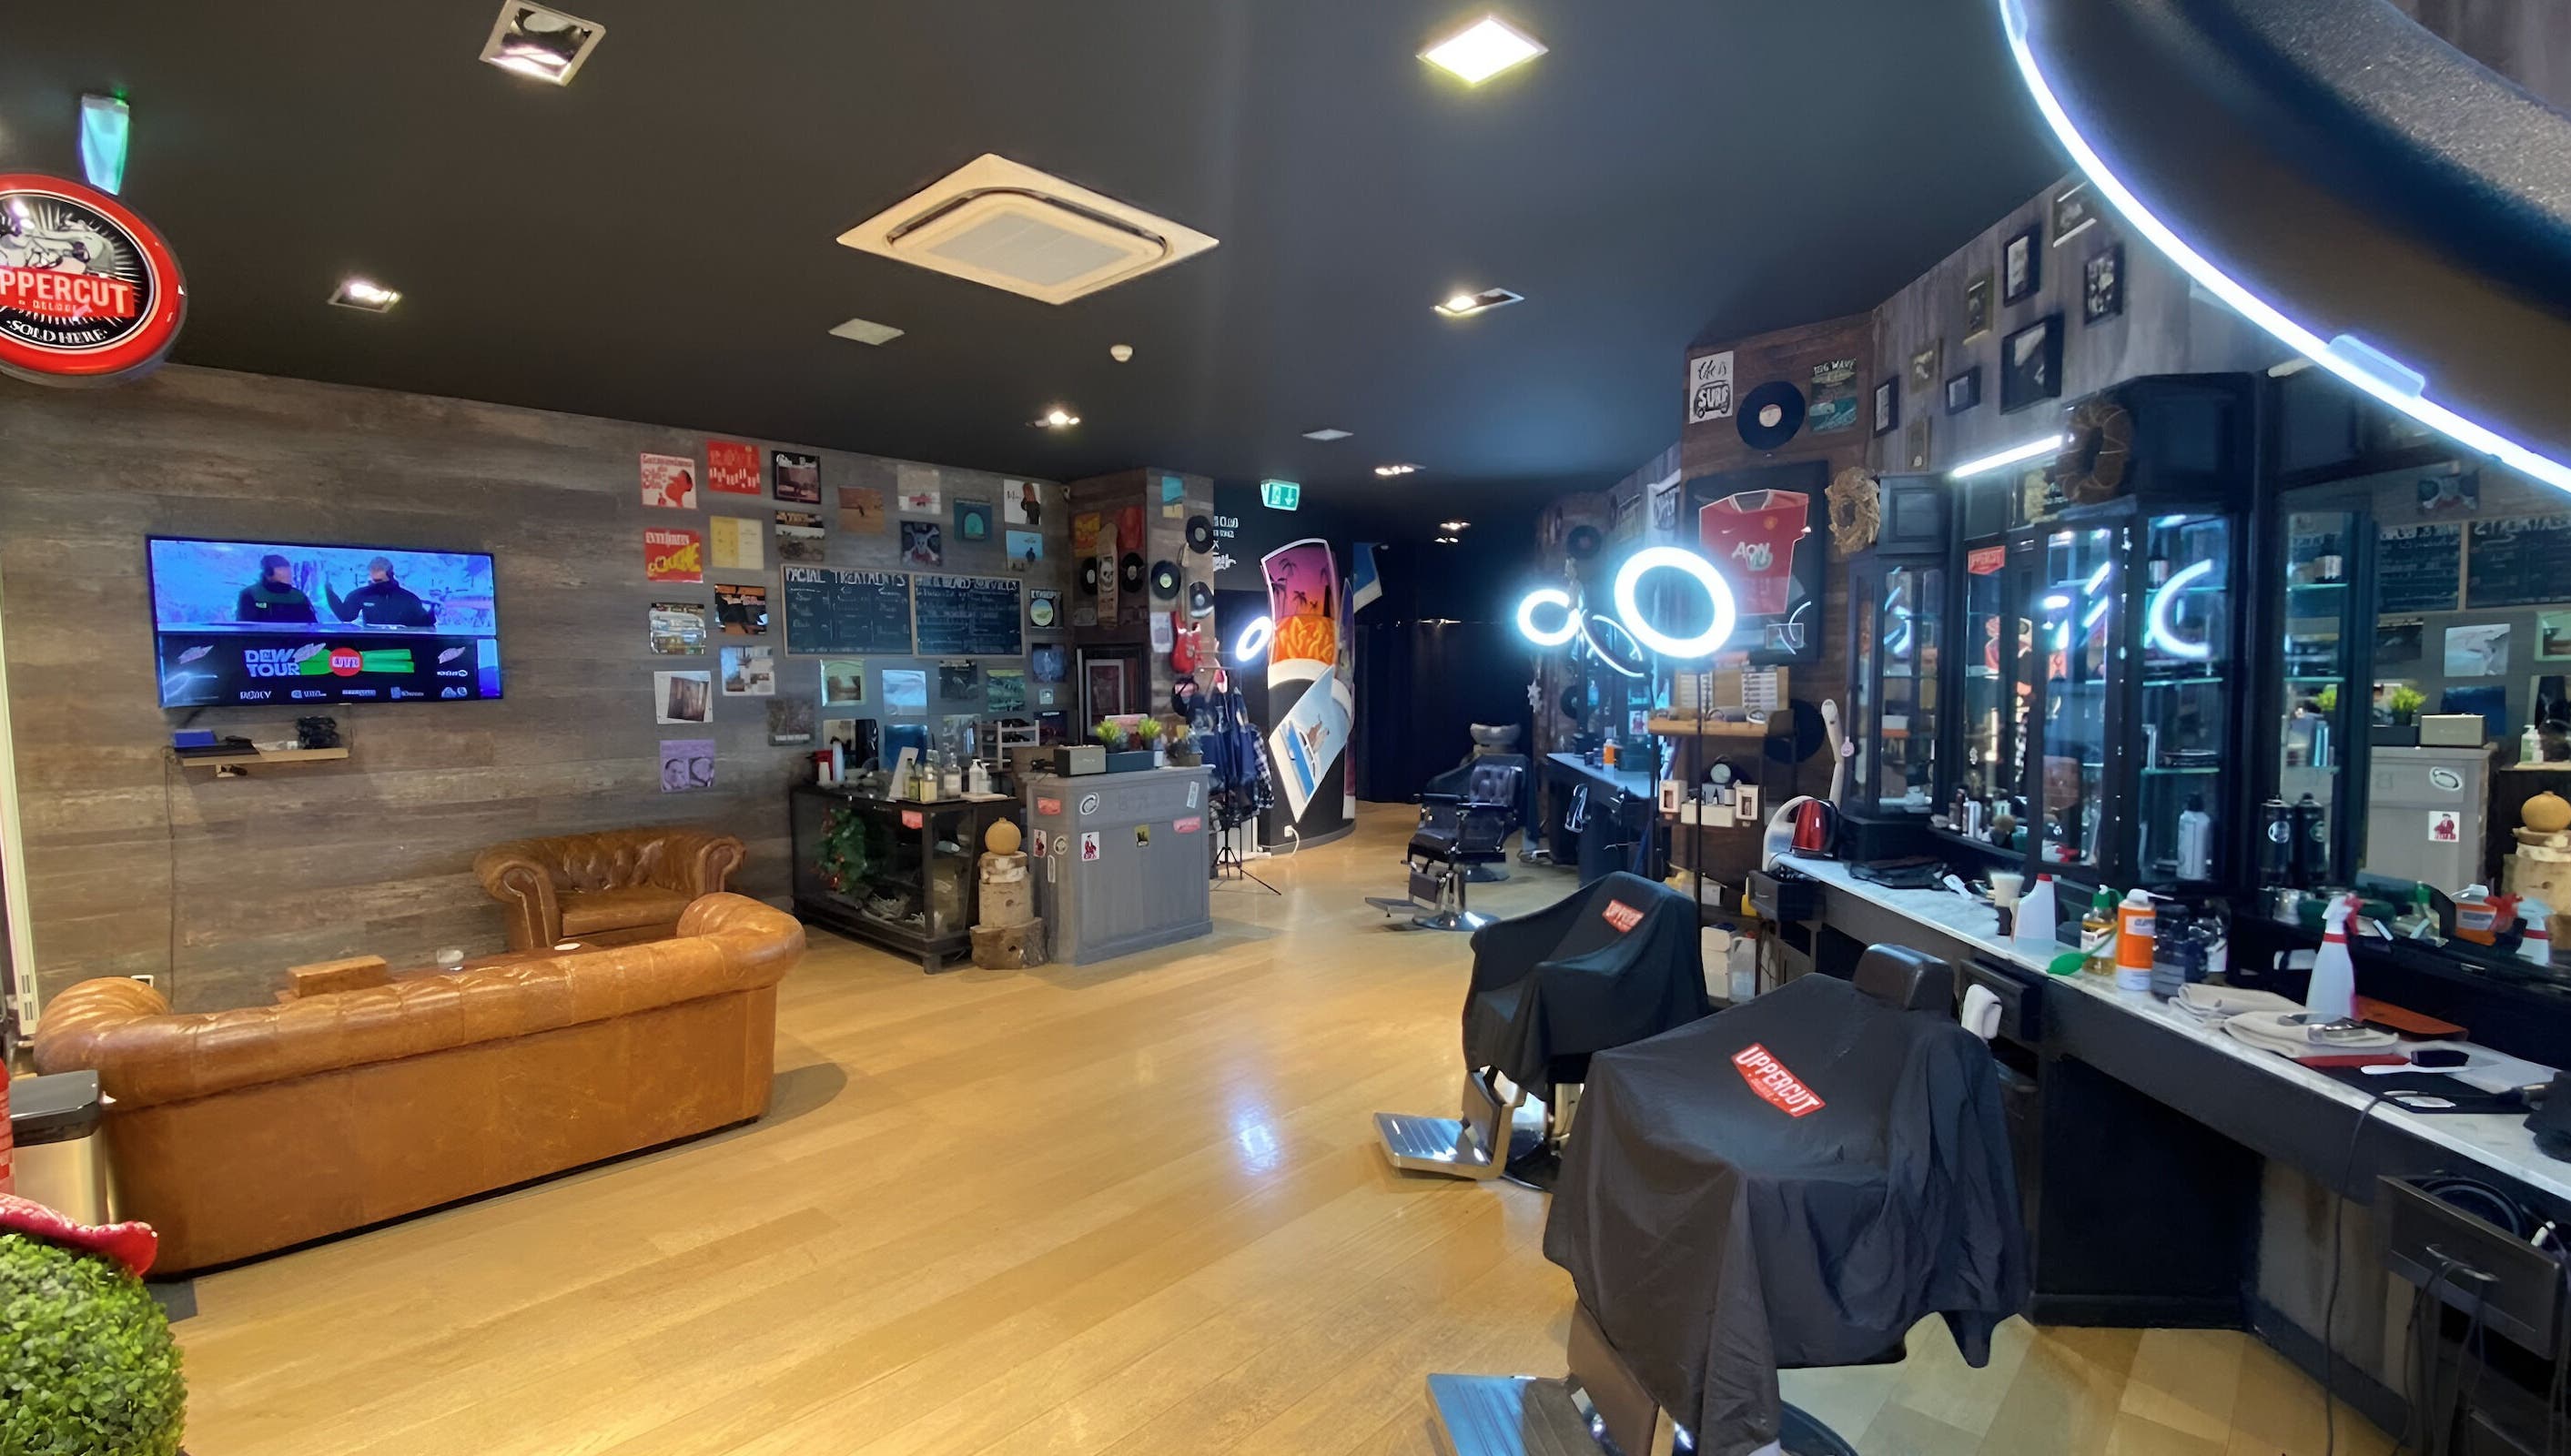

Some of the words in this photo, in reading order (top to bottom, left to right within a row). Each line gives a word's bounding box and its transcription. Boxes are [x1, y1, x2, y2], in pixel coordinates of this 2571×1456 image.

[1697, 386, 1729, 409] SURF
[244, 649, 295, 663] DEW
[246, 662, 300, 677] TOUR
[1736, 1046, 1820, 1113] UPPERCUT
